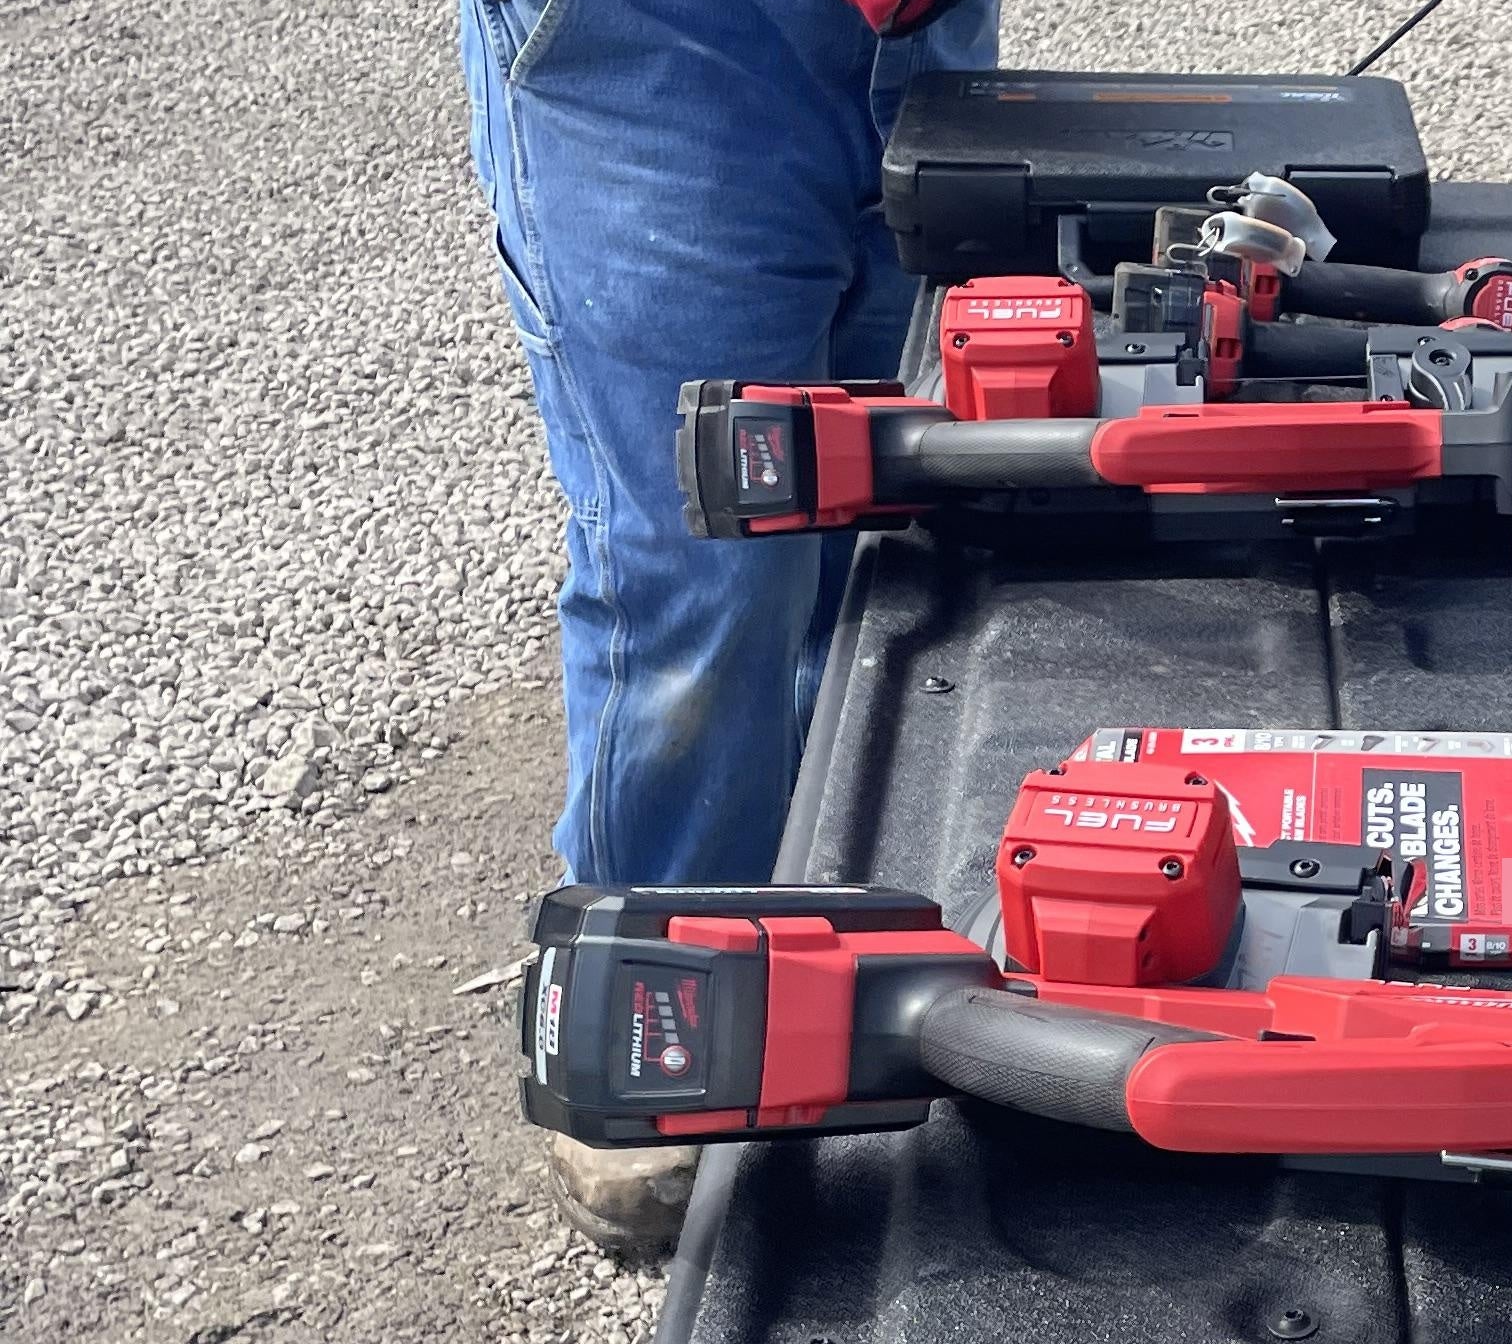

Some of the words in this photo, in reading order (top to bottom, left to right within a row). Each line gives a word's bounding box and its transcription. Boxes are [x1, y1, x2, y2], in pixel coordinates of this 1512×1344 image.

[968, 307, 1062, 320] FUEL
[1191, 737, 1219, 746] 3
[1050, 795, 1182, 813] BRUSHLESS
[1044, 808, 1177, 834] FUEL
[1366, 782, 1395, 849] CUTS.
[1400, 782, 1427, 857] BLADE
[1433, 805, 1464, 916] CHANGES.
[1468, 937, 1477, 951] 3
